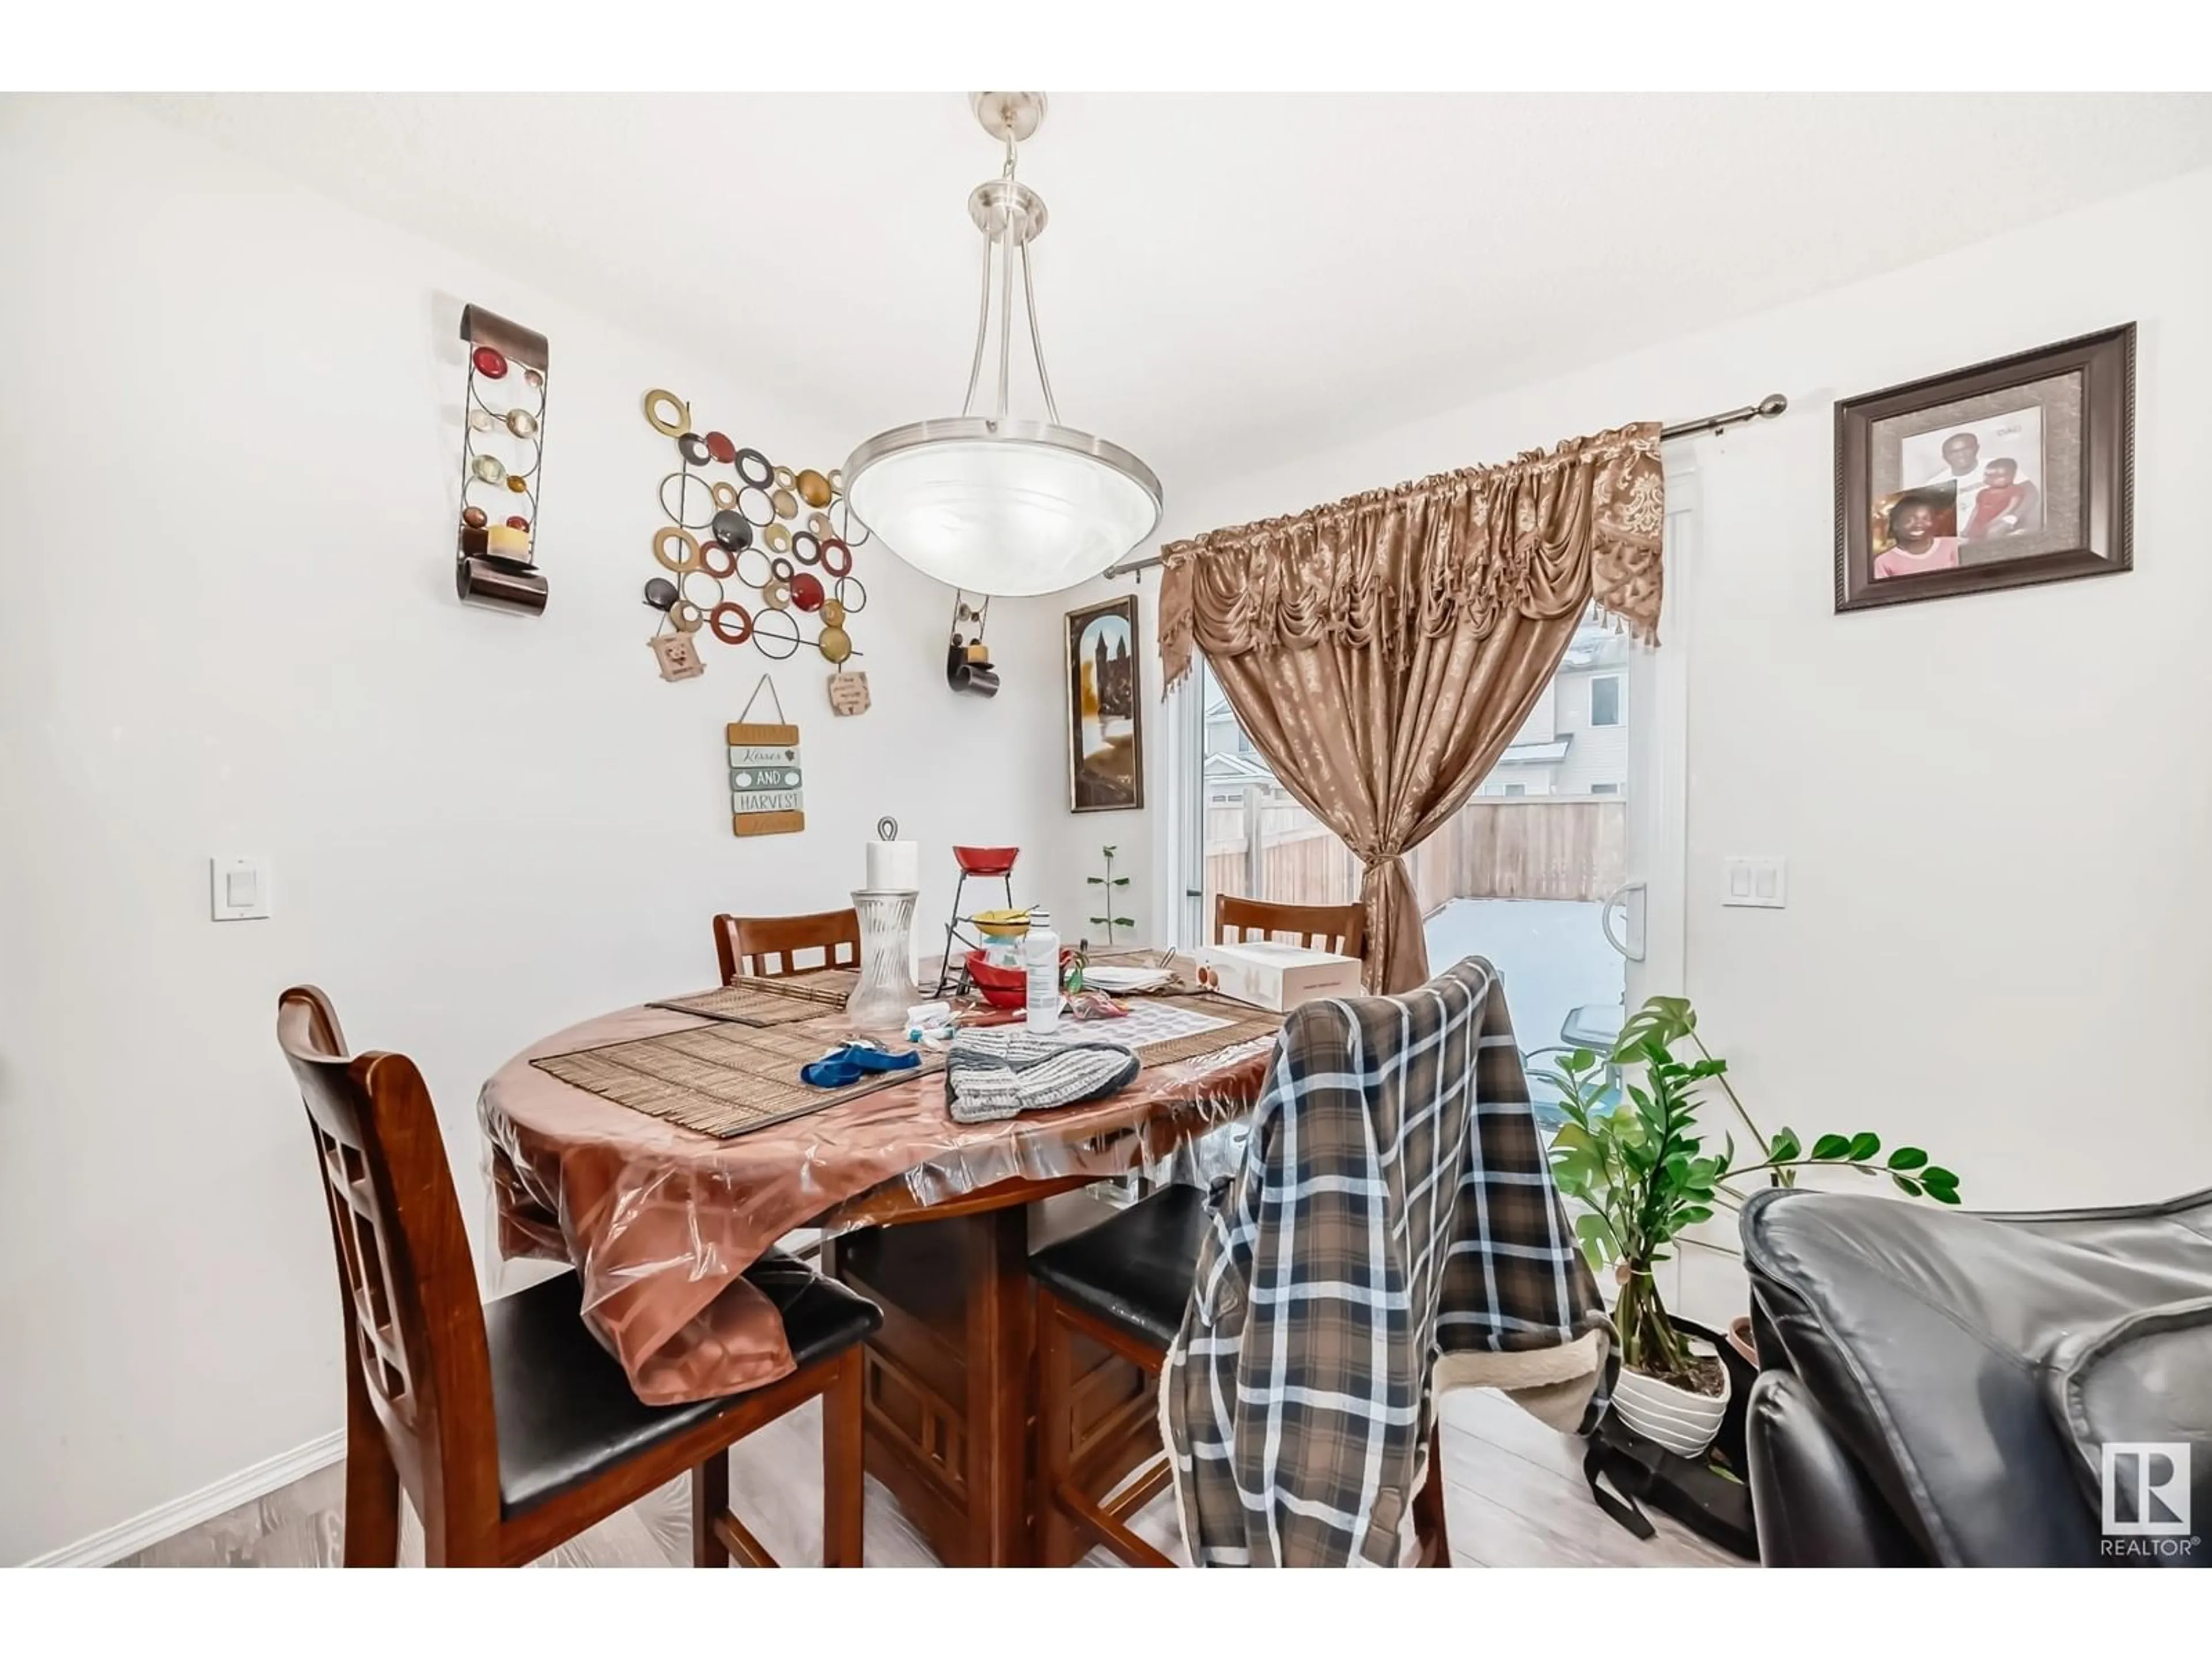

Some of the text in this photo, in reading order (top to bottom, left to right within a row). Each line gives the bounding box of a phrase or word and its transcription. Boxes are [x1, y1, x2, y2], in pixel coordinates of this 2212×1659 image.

[743, 749, 781, 763] Kisses
[756, 771, 781, 785] AND
[740, 793, 798, 811] HARVEST
